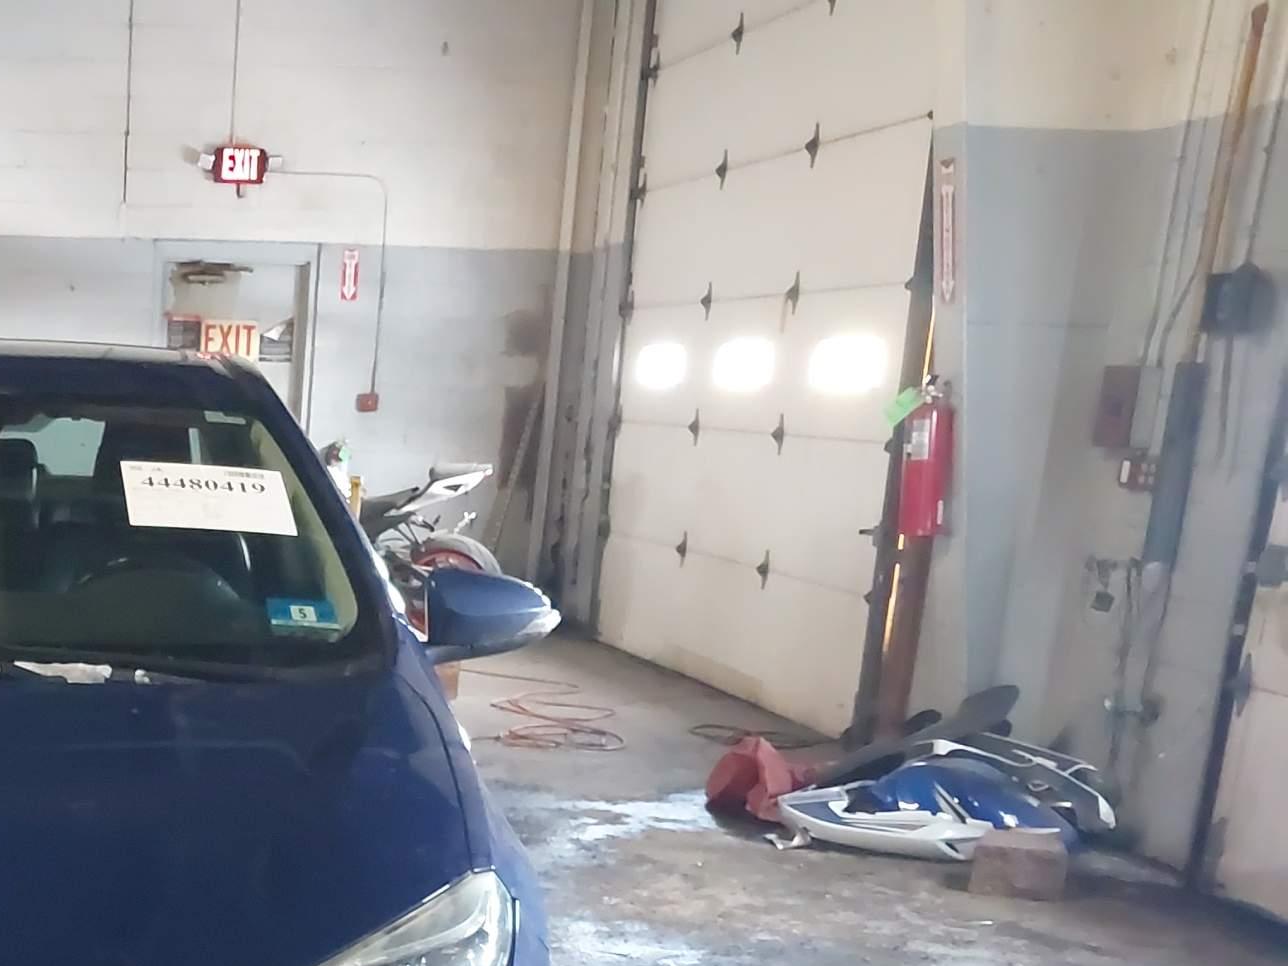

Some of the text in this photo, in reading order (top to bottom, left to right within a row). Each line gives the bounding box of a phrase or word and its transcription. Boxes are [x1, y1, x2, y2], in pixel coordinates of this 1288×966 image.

[222, 148, 260, 180] EXIT
[204, 324, 256, 356] EXIT
[141, 476, 265, 493] 44480419
